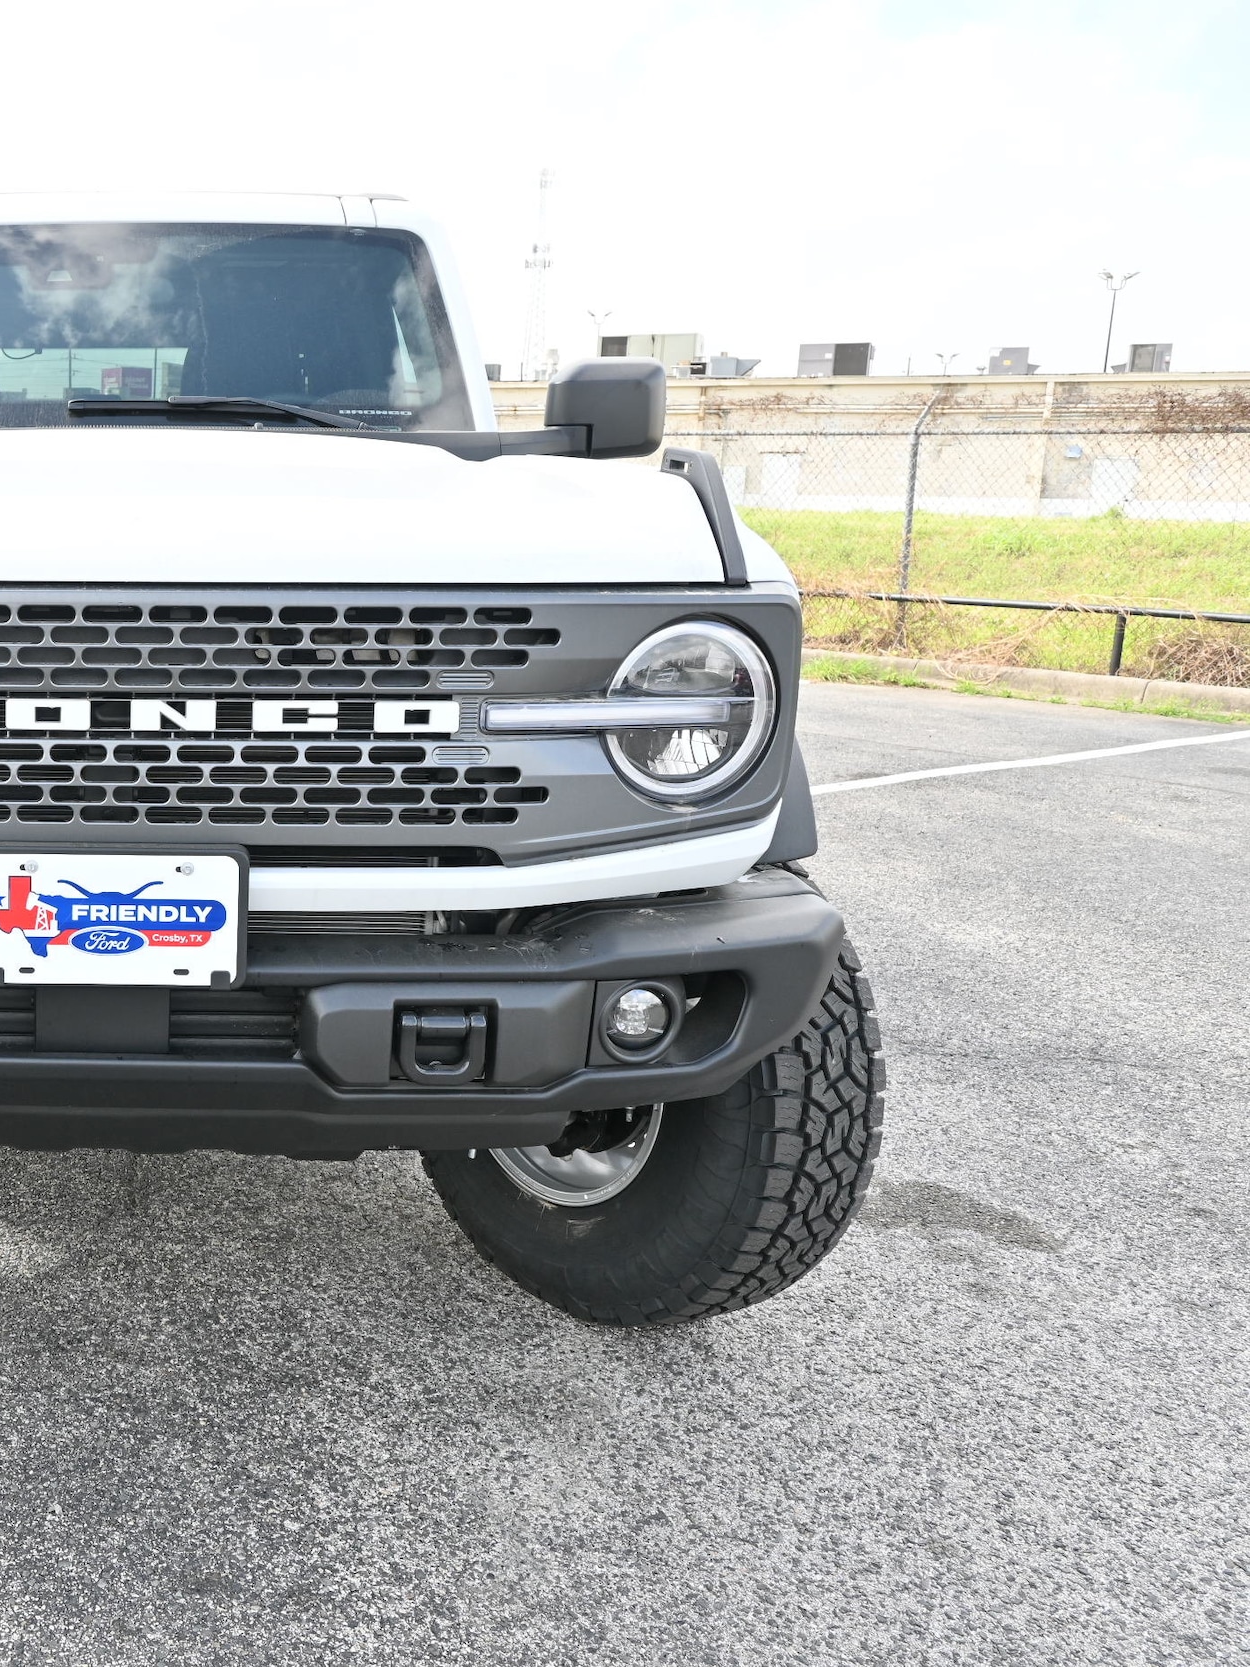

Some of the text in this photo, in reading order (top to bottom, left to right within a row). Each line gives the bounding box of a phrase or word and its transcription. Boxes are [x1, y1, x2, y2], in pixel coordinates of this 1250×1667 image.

[71, 904, 213, 923] FRIENDLY
[85, 931, 131, 950] Ford
[152, 933, 203, 944] Crosby, TX
